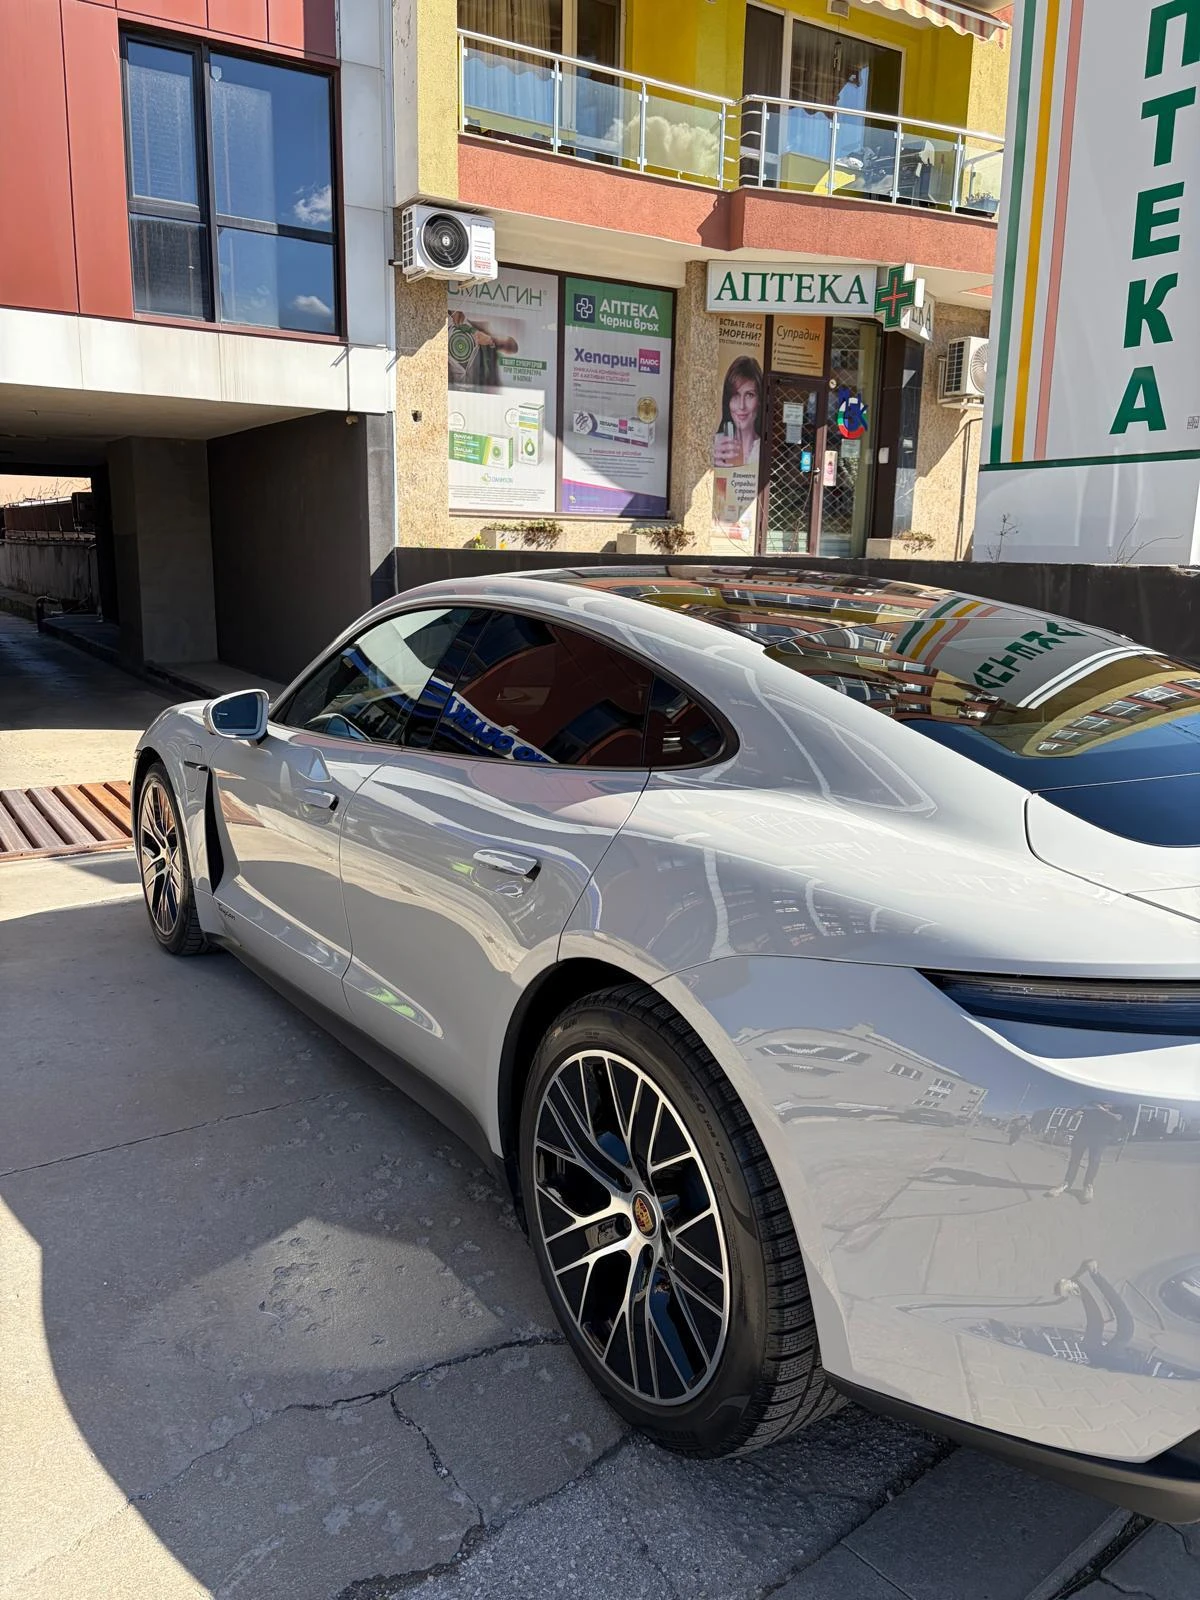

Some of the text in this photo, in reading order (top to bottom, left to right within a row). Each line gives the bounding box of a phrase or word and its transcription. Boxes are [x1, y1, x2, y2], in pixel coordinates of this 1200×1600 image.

[1109, 0, 1200, 435] ПТЕКА
[714, 271, 869, 305] АПТЕКА
[600, 298, 659, 320] АПТЕКА
[599, 313, 659, 332] Черни връх
[719, 317, 745, 329] ВСТВАТЕ
[718, 328, 762, 341] ЗМОРЕНИ?
[777, 325, 821, 341] Супрадин
[574, 347, 660, 369] Хепарин ПЛЮС
